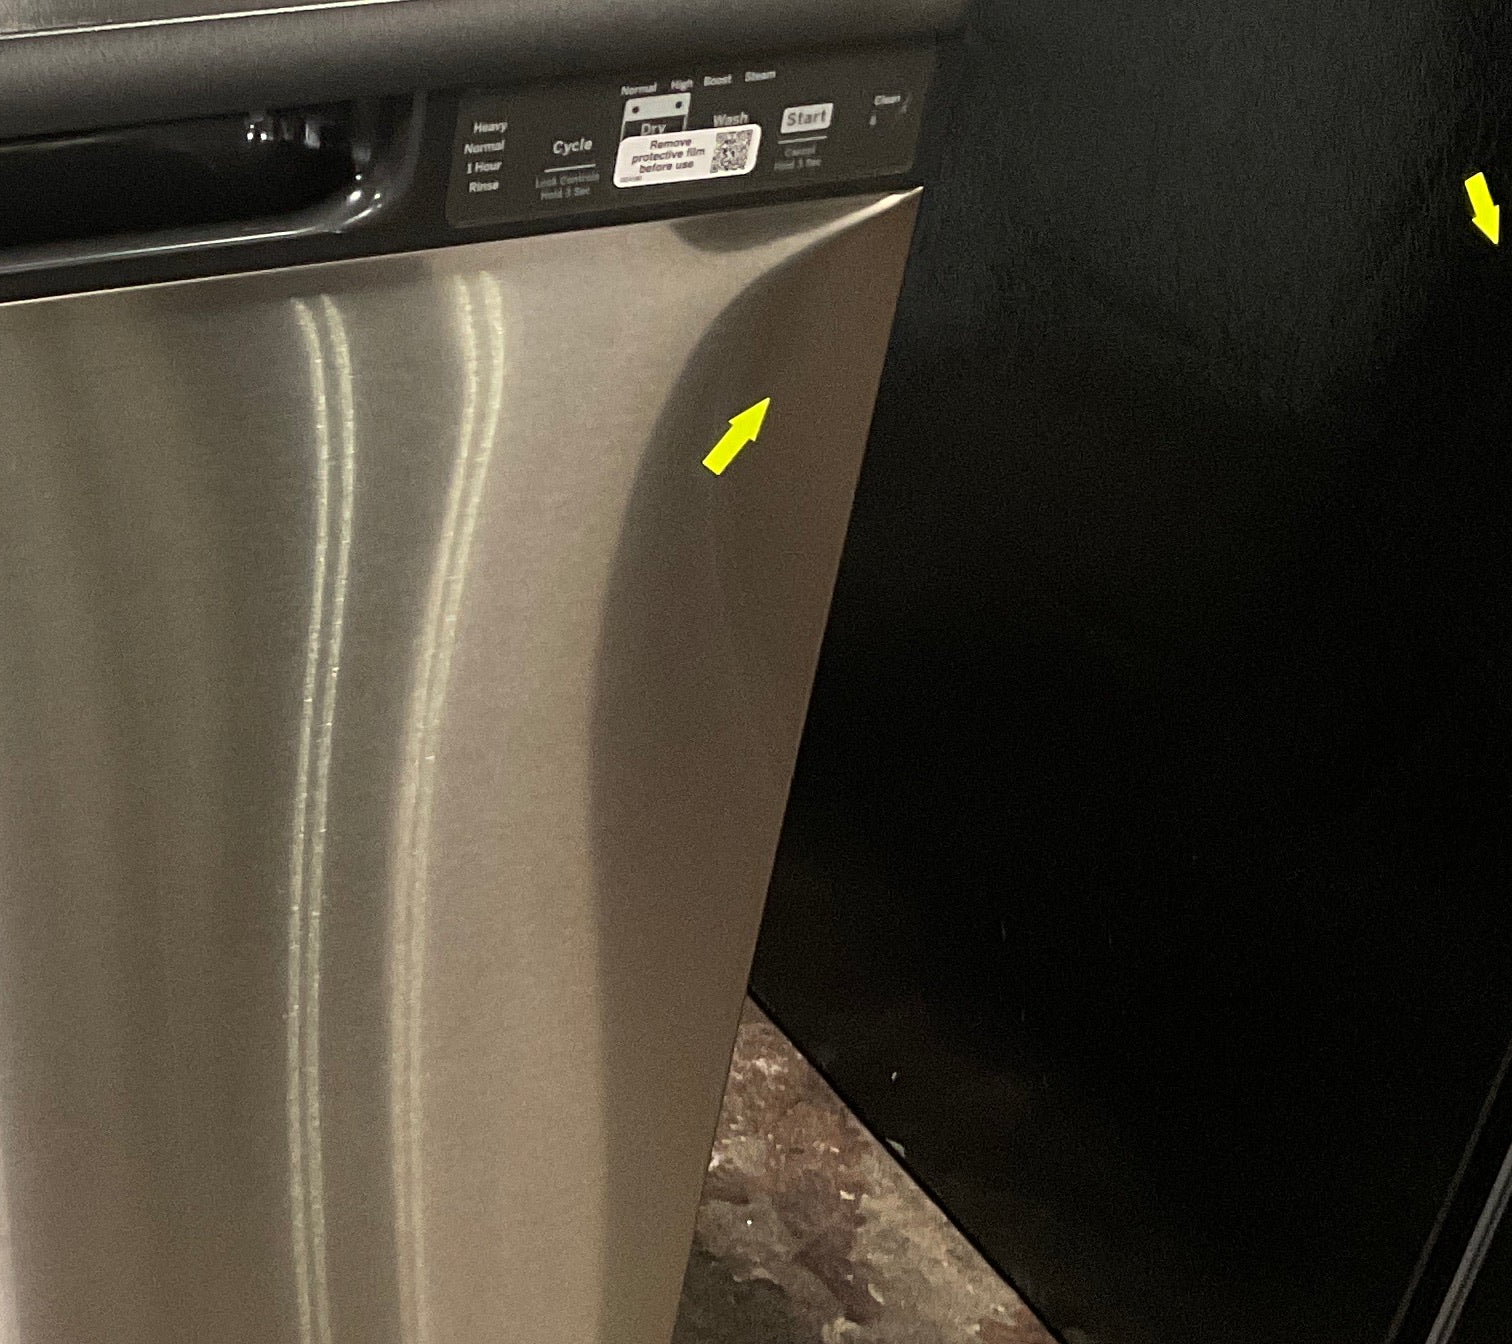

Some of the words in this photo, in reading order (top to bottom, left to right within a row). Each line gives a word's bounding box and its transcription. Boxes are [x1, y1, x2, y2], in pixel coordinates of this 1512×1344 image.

[621, 82, 657, 95] Normal
[671, 79, 693, 92] High
[704, 74, 732, 87] Boost
[745, 71, 776, 82] Steam
[641, 123, 667, 136] Dry
[713, 112, 749, 128] Wash
[787, 110, 826, 127] Start
[473, 121, 508, 134] Heavy
[464, 139, 506, 155] Normal
[553, 137, 593, 156] Cycle
[649, 139, 692, 150] Remove
[631, 151, 684, 165] protective
[686, 147, 705, 157] film
[467, 163, 473, 174] 1
[475, 161, 502, 173] Hour
[639, 162, 672, 174] before
[675, 160, 694, 170] use
[469, 181, 500, 193] Rinse
